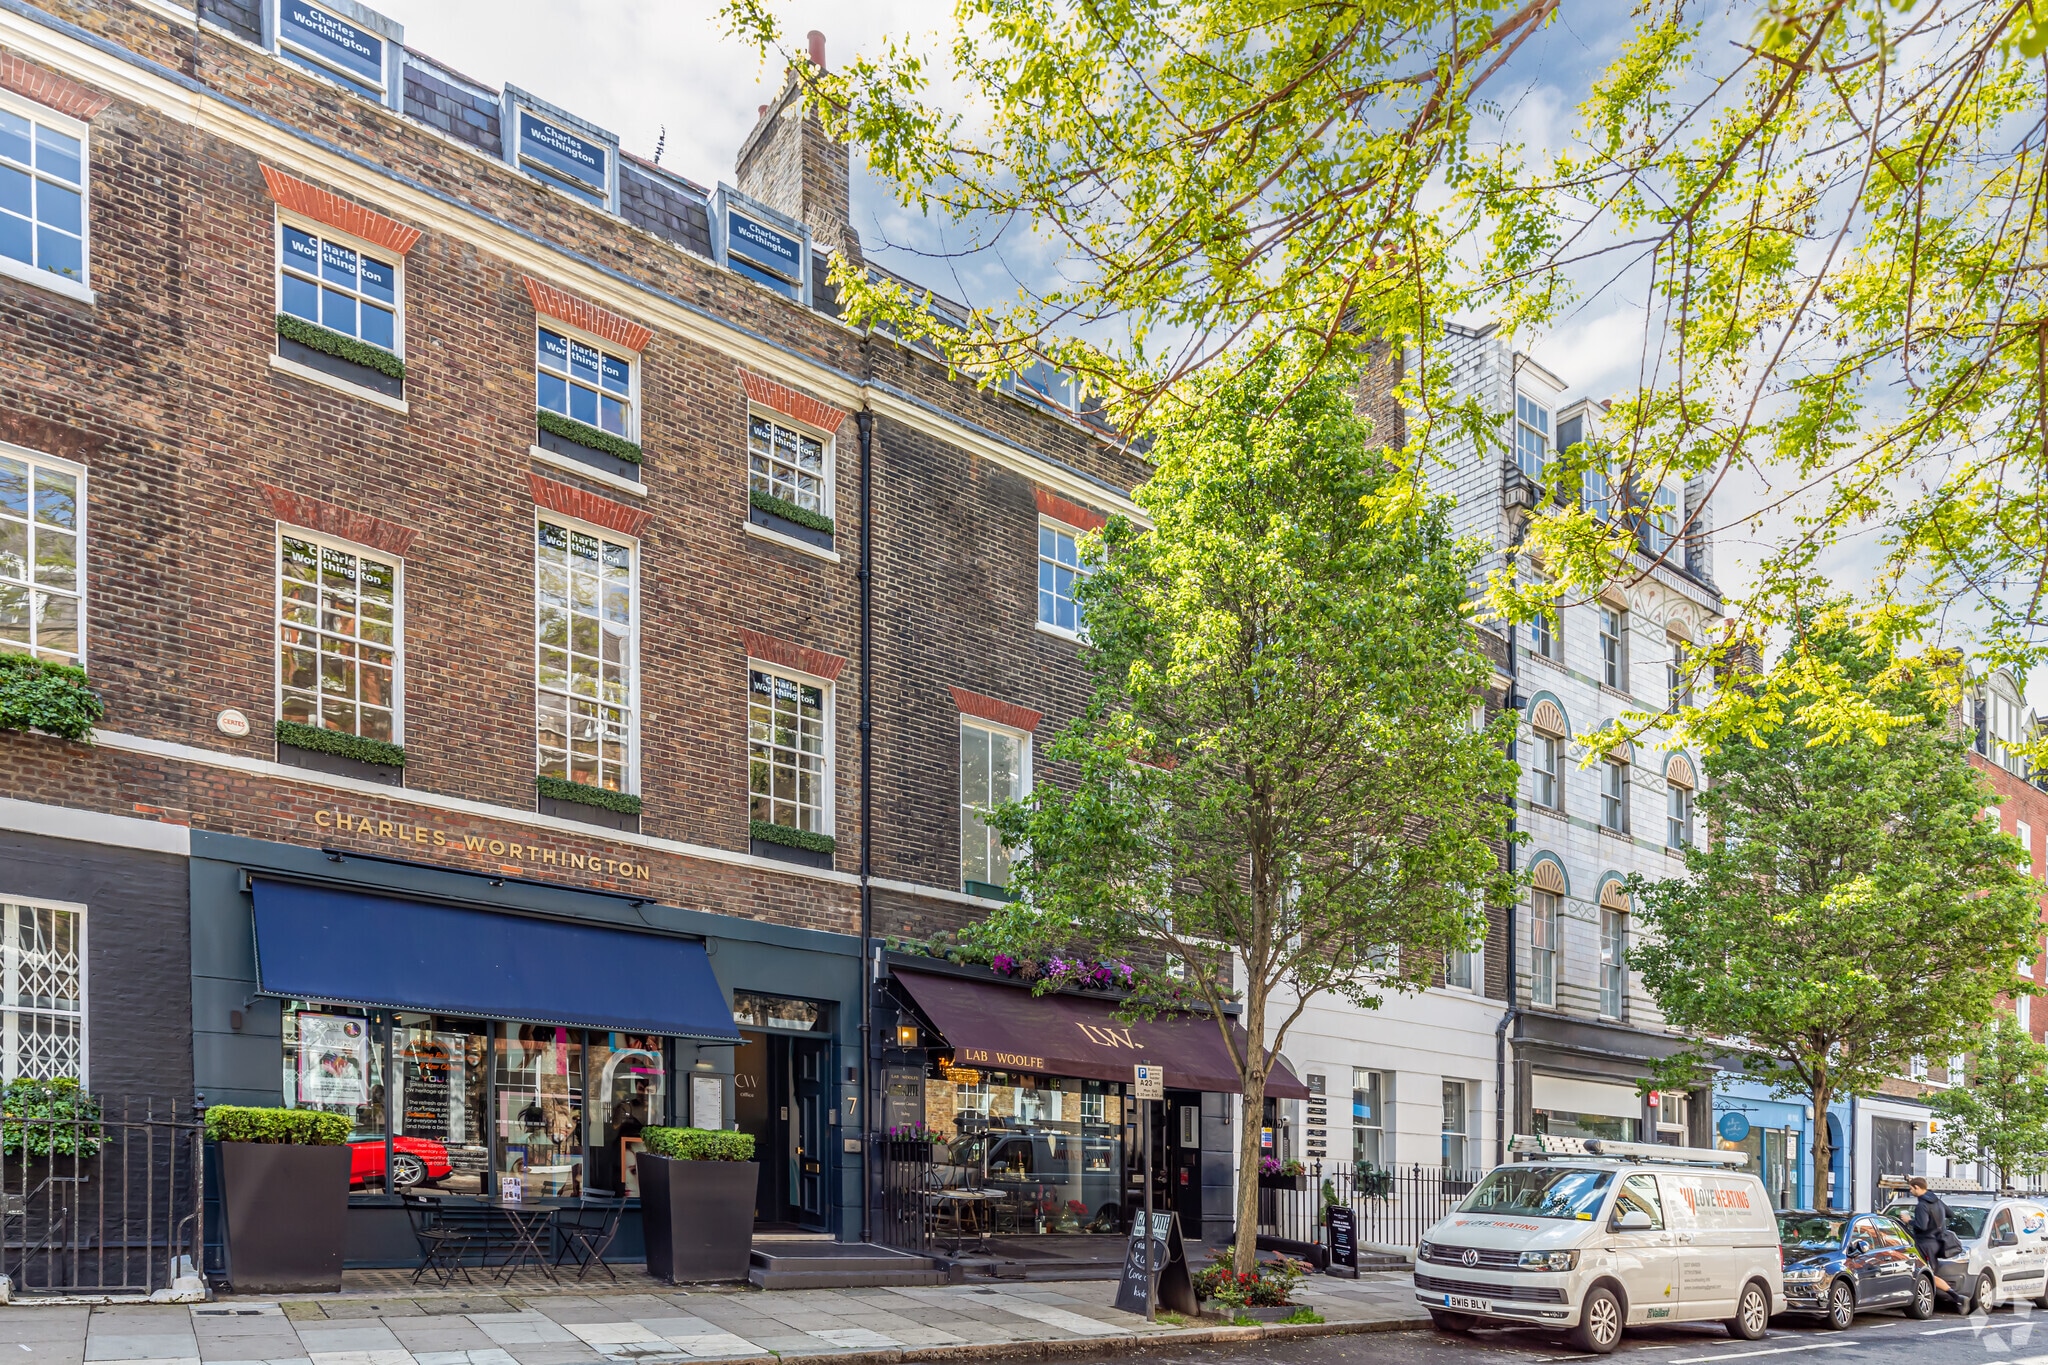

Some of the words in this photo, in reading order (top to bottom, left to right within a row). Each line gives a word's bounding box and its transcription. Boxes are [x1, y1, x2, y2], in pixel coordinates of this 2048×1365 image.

[293, 11, 371, 56] Worthington
[310, 10, 355, 38] Charles
[530, 128, 595, 165] Worthington
[544, 126, 582, 149] Charles
[738, 226, 792, 257] Worthington
[749, 223, 780, 243] Charles
[291, 240, 382, 282] Worthington
[308, 237, 367, 266] Charles
[545, 341, 619, 377] Worthington
[559, 338, 607, 363] Charles
[753, 426, 814, 456] Worthington
[765, 423, 804, 444] Charles
[546, 534, 620, 564] Worthington
[559, 530, 607, 552] Charles
[291, 551, 382, 584] Worthington
[308, 546, 367, 570] Charles
[754, 681, 815, 705] Worthington
[765, 676, 805, 694] Charles
[222, 718, 246, 728] CERTES
[314, 809, 447, 846] CHARLES
[463, 834, 651, 880] WORTHINGTON
[966, 1049, 988, 1062] LAB
[997, 1052, 1044, 1069] WOOLFE
[421, 1075, 445, 1083] YOU
[424, 1081, 449, 1089] inspiration
[734, 1073, 760, 1088] CW
[847, 1097, 857, 1115] 7
[1451, 1297, 1469, 1308] BW16
[1470, 1299, 1488, 1310] BLV
